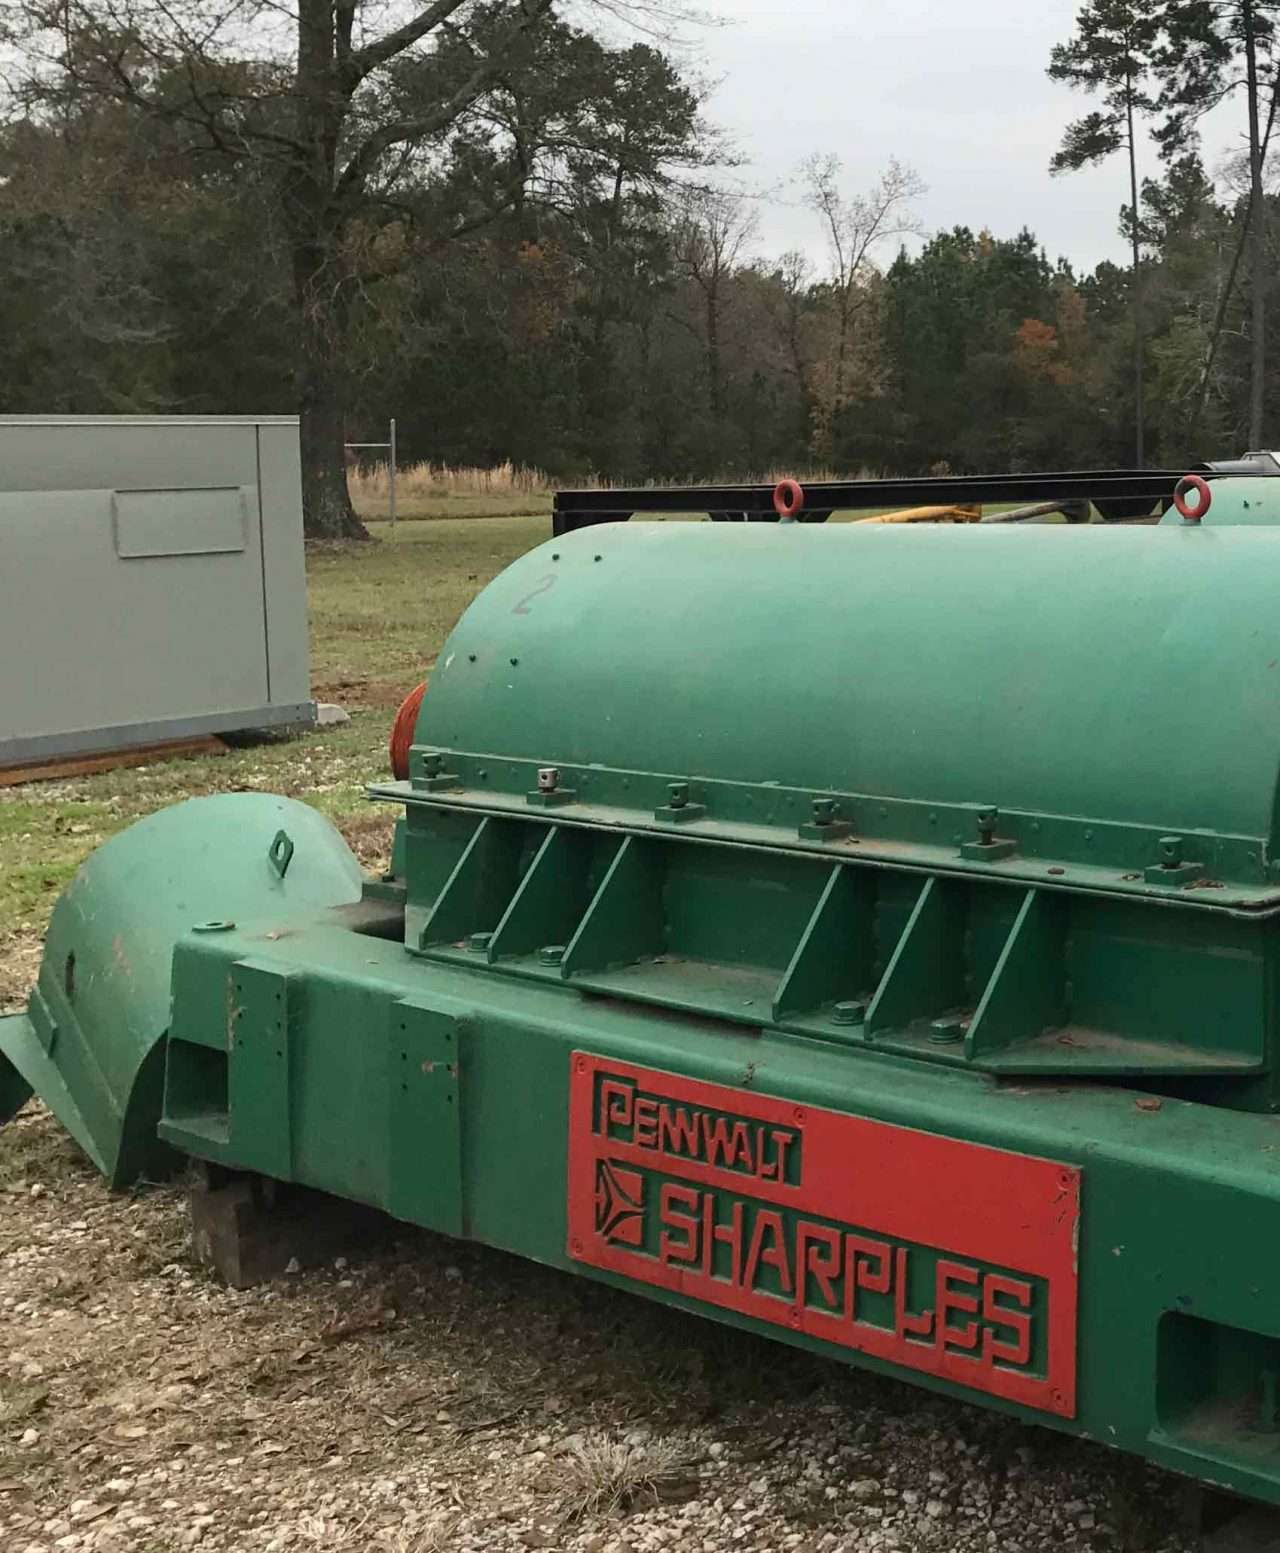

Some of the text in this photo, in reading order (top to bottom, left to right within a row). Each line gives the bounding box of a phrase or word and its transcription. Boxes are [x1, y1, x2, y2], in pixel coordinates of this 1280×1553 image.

[511, 573, 558, 615] 2
[601, 1079, 793, 1185] PENNWALT
[659, 1182, 1032, 1367] SHARPLES
